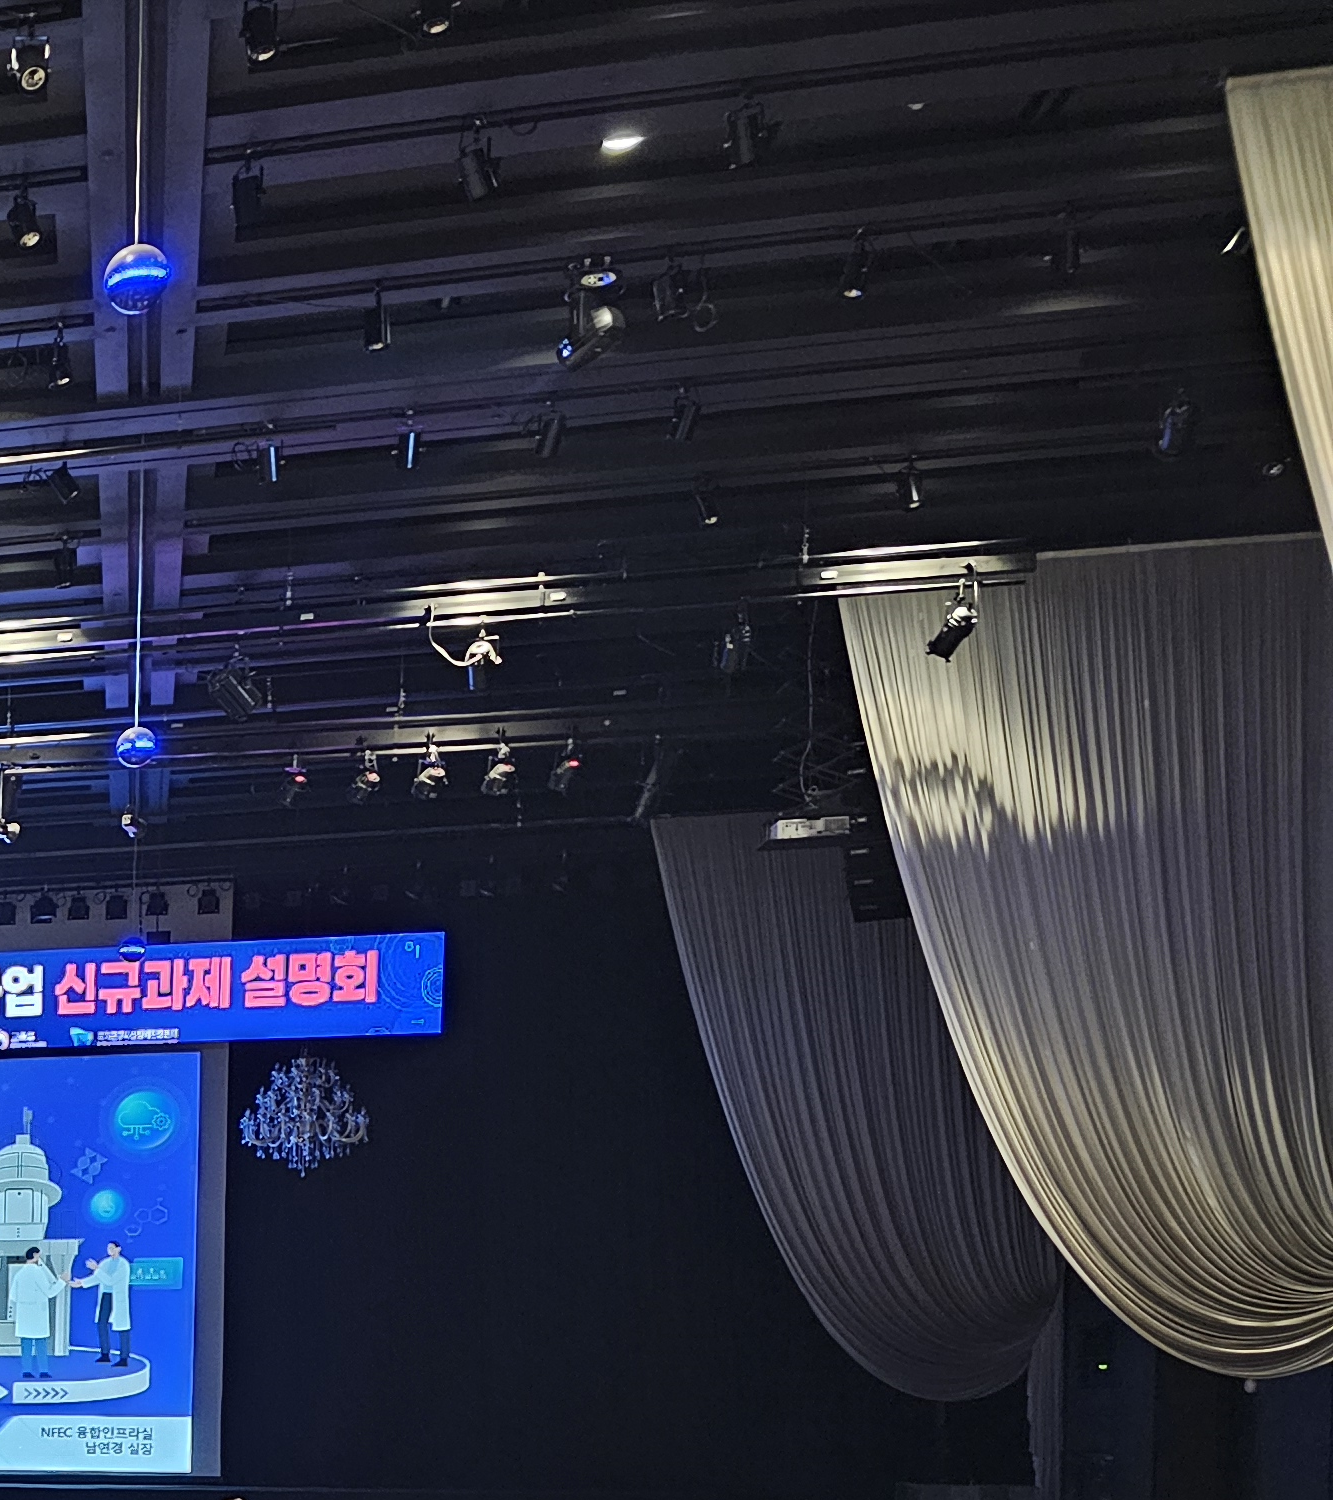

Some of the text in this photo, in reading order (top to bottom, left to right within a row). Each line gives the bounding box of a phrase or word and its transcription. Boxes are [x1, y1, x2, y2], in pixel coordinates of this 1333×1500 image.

[55, 957, 232, 1015] 신규과제
[241, 949, 379, 1008] 설명회
[40, 1426, 153, 1441] NFEC 융합인프라실
[85, 1441, 154, 1456] 남연경 실장
